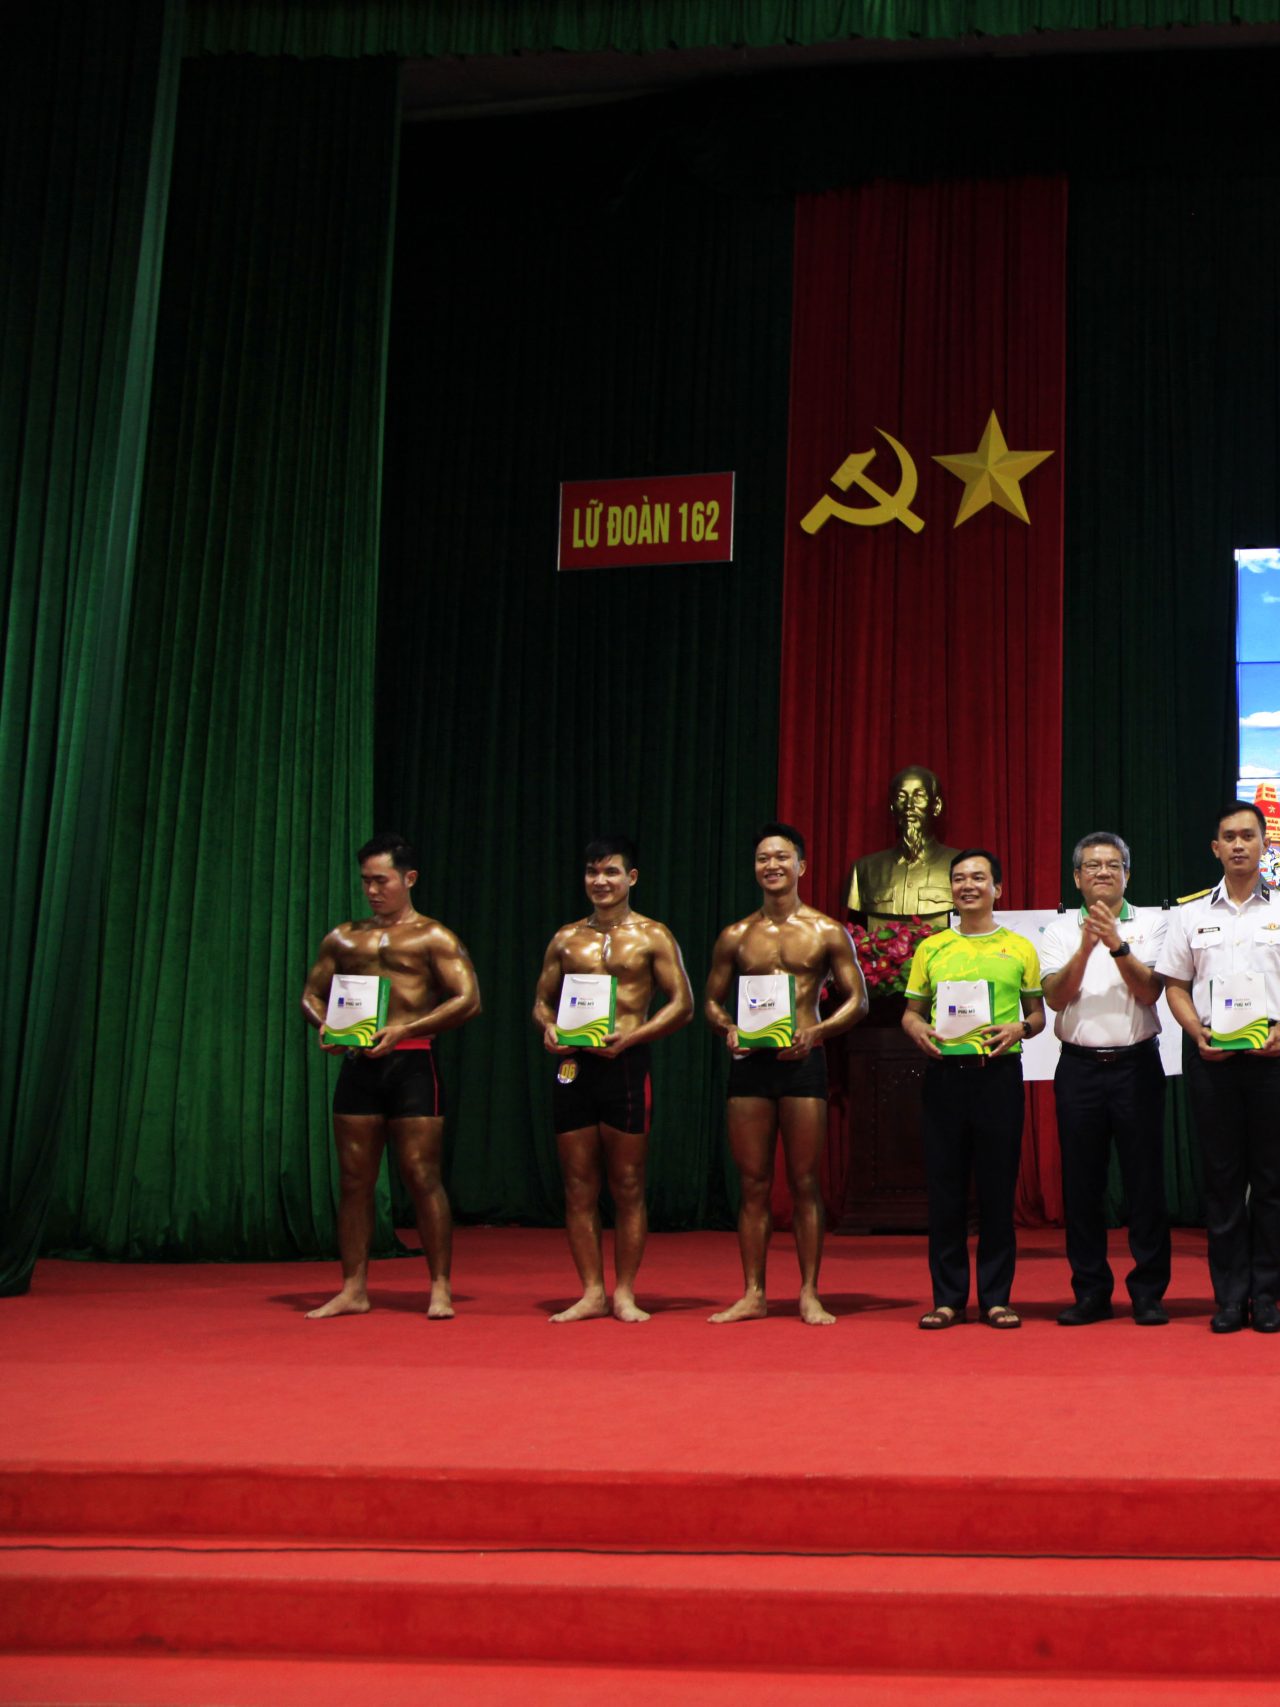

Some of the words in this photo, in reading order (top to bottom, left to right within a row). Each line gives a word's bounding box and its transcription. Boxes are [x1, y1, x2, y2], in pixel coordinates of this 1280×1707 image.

[573, 499, 604, 548] LỮ
[607, 495, 670, 547] ĐOÀN
[678, 500, 720, 542] 162
[561, 1063, 577, 1079] 06
